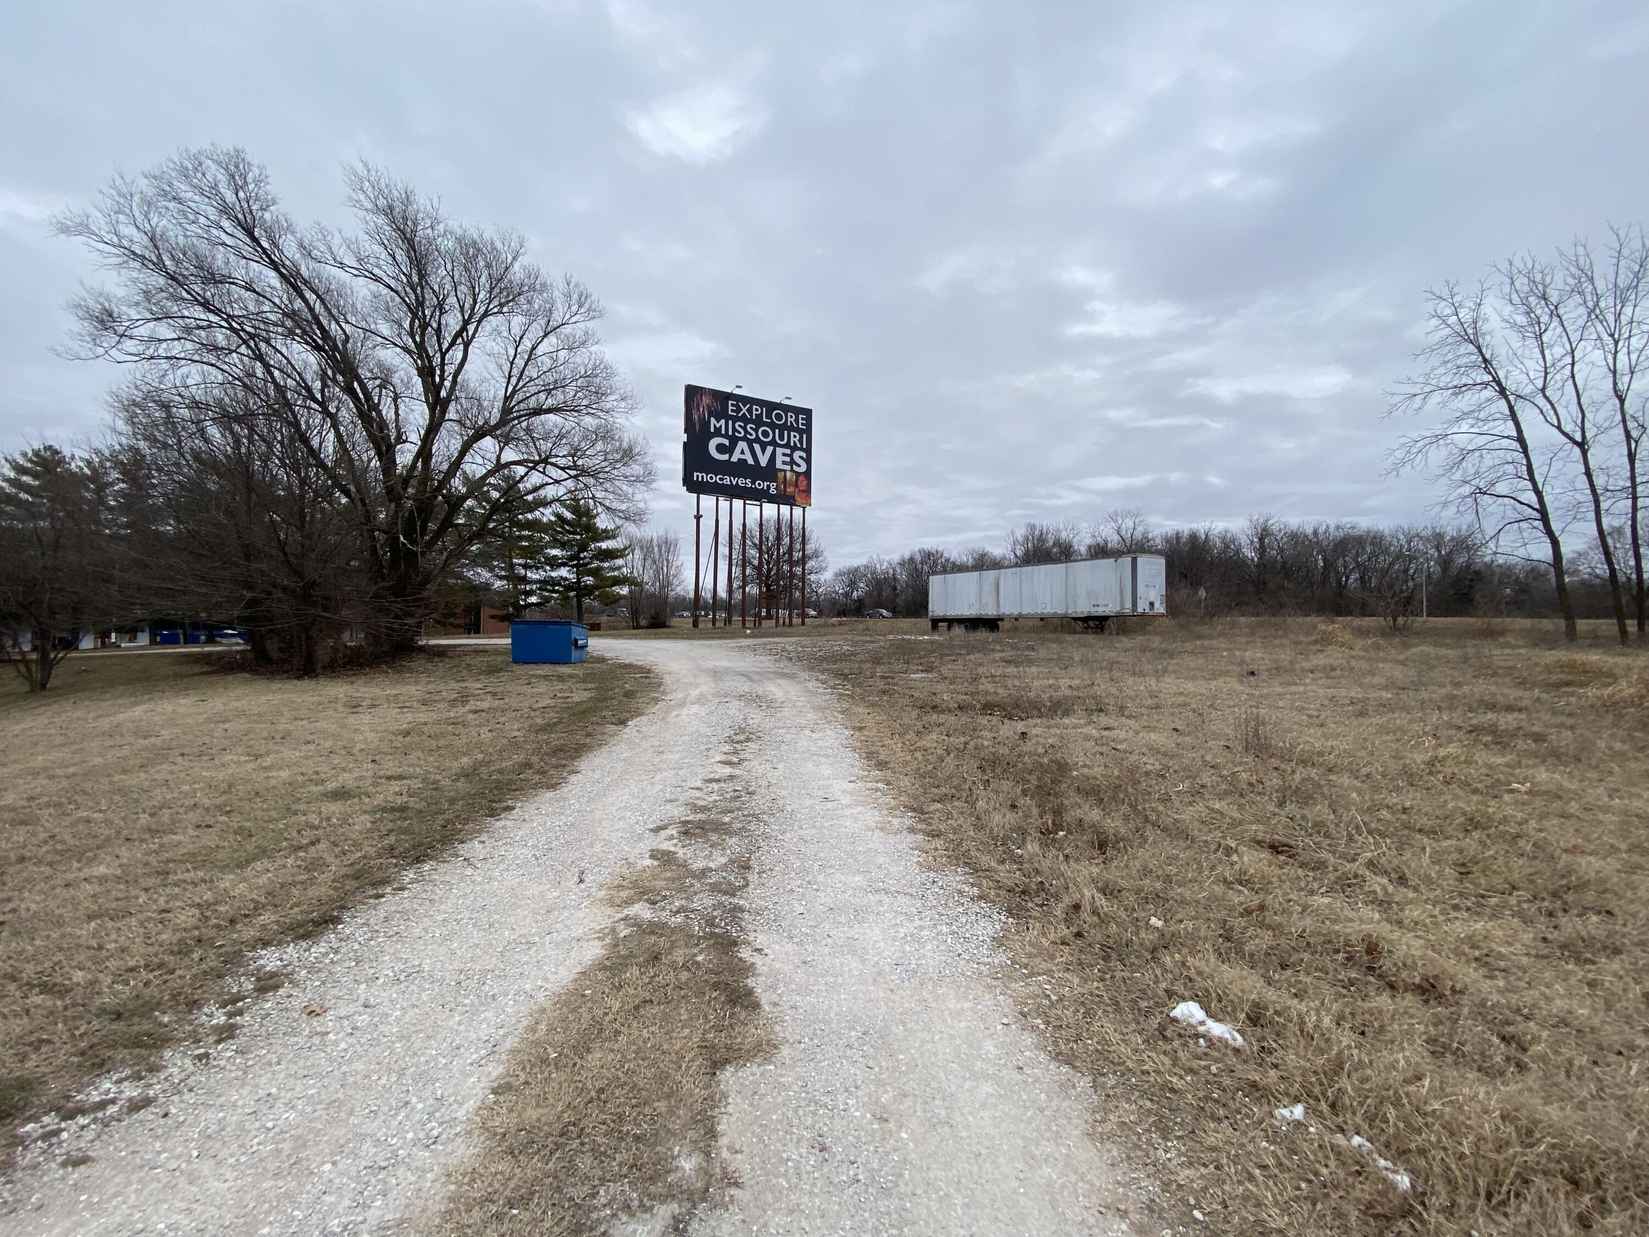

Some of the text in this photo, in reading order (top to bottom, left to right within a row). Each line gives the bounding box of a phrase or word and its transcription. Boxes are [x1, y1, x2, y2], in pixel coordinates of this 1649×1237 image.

[728, 400, 806, 429] EXPLORE
[710, 417, 806, 449] MISSOURI
[708, 437, 807, 473] CAVES
[693, 471, 777, 494] mocaves.org
